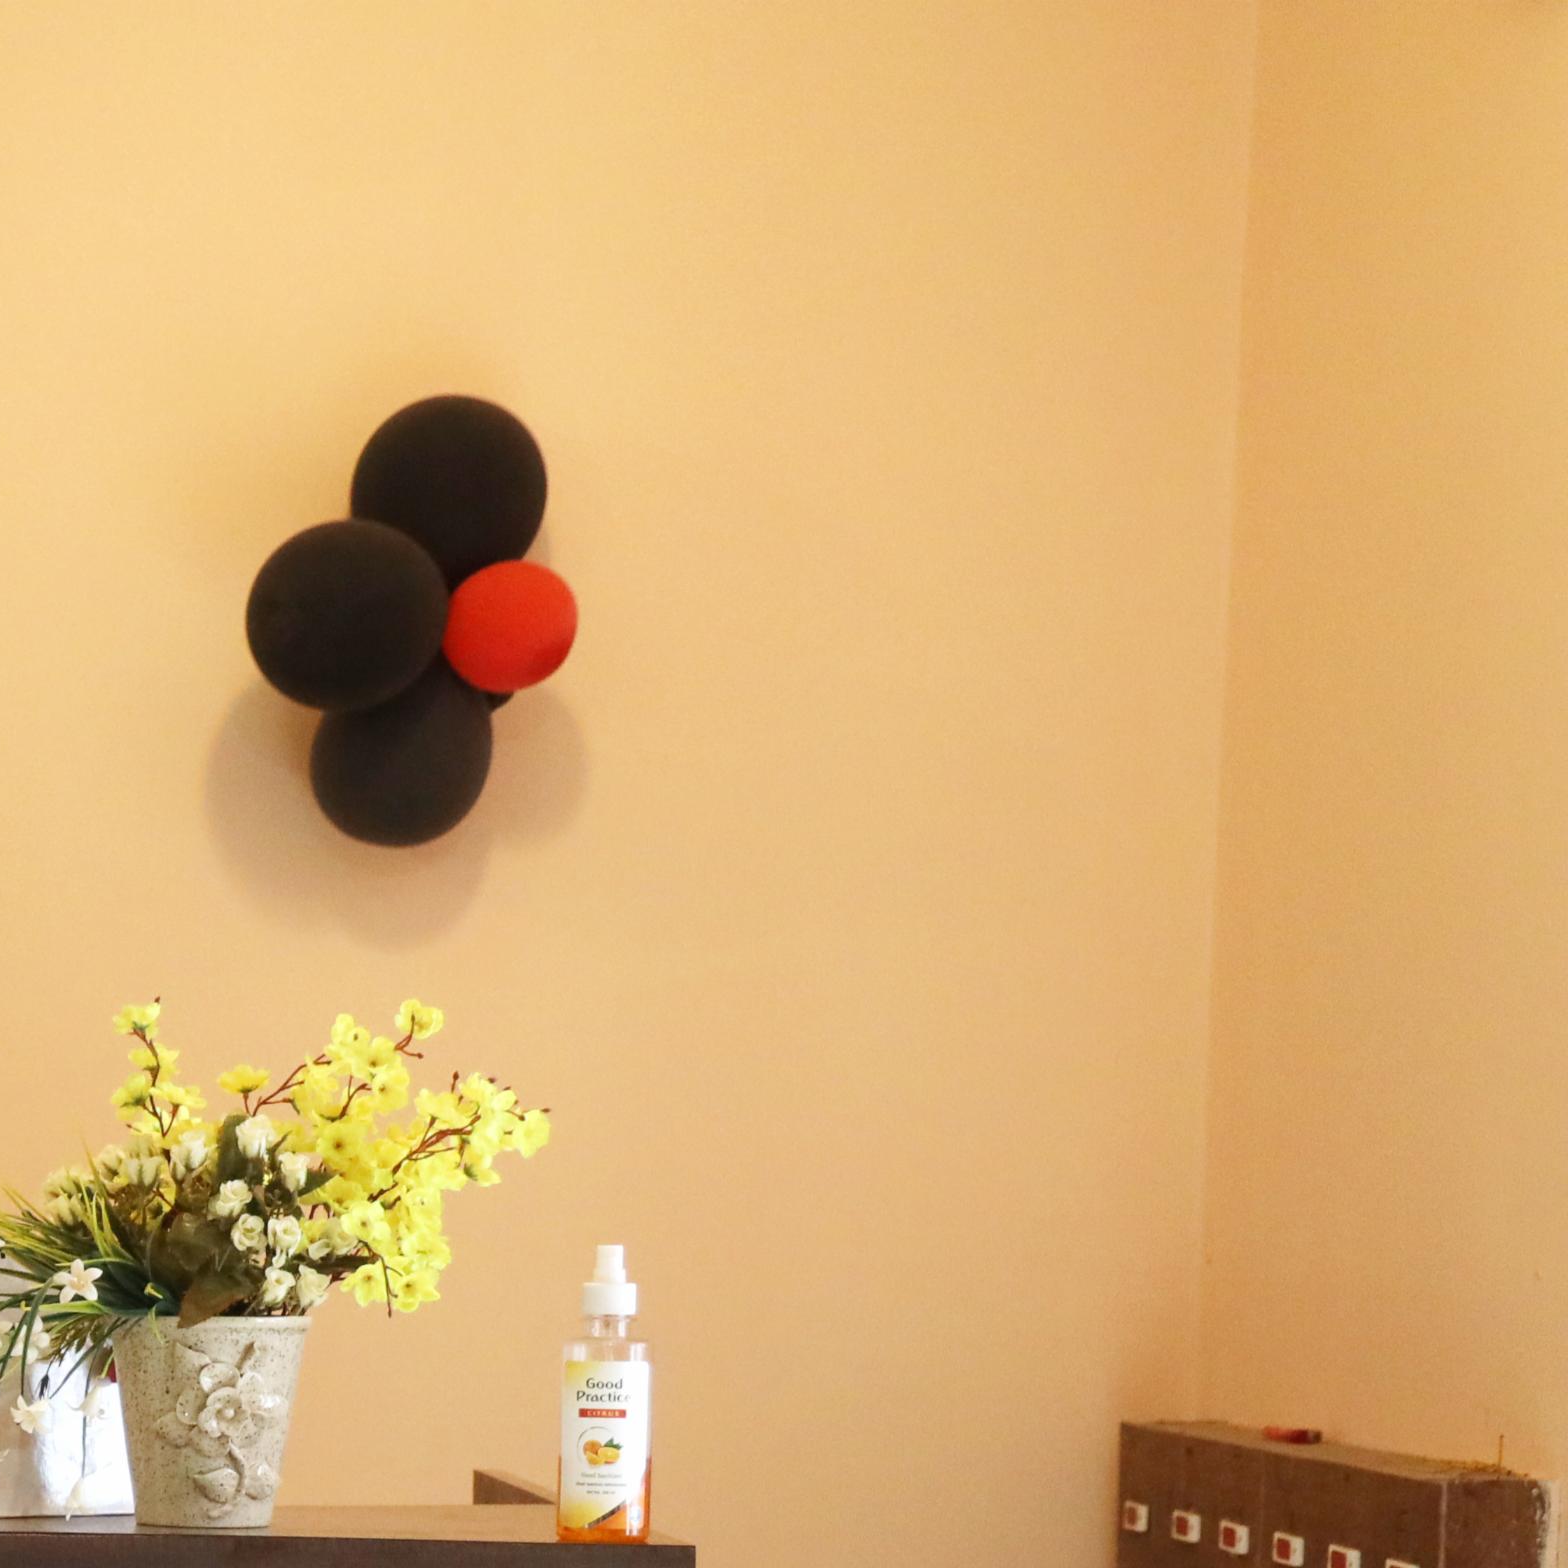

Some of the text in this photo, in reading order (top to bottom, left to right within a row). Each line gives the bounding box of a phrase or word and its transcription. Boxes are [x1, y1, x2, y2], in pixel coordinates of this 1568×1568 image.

[586, 1377, 623, 1389] Good
[576, 1390, 631, 1403] Practice
[587, 1410, 620, 1418] CITRUS
